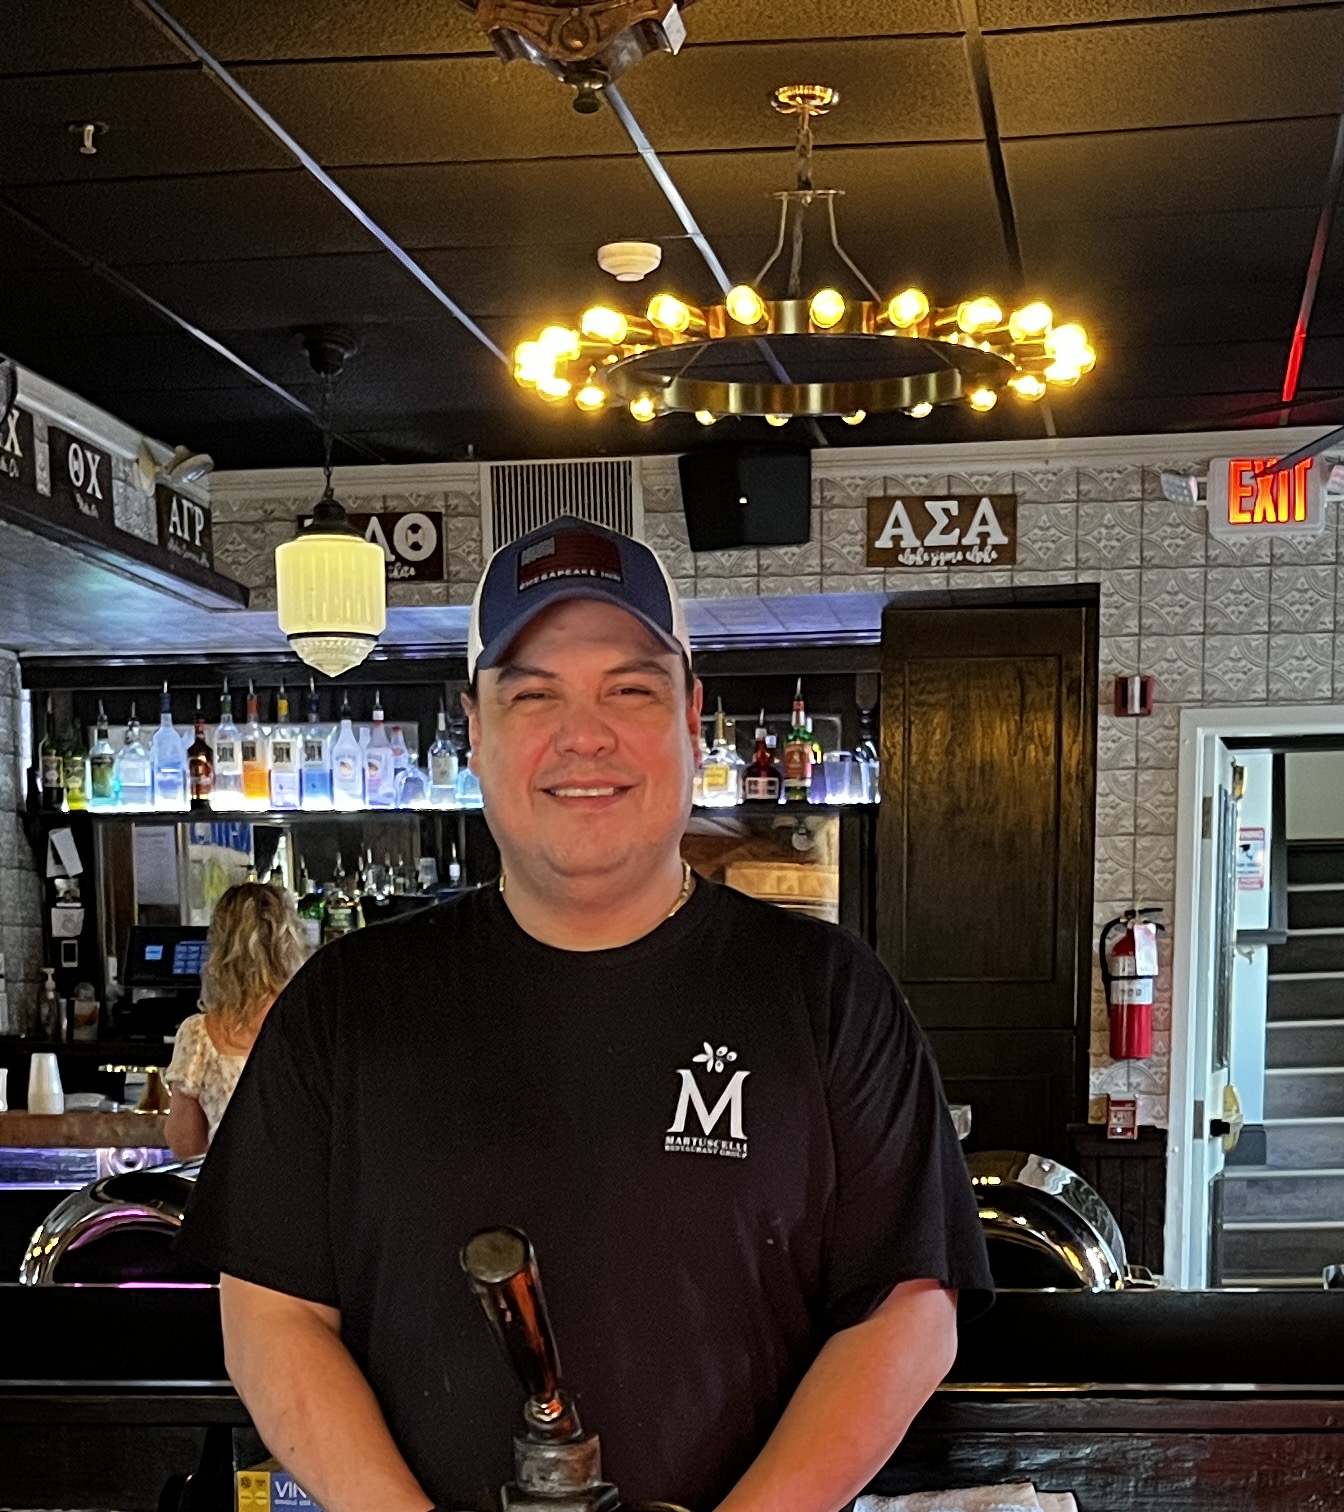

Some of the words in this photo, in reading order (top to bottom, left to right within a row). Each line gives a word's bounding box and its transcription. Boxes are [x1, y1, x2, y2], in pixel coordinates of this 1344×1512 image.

[874, 497, 1009, 549] ΑΣΑ
[1228, 457, 1313, 524] EXIT
[666, 1069, 751, 1140] M
